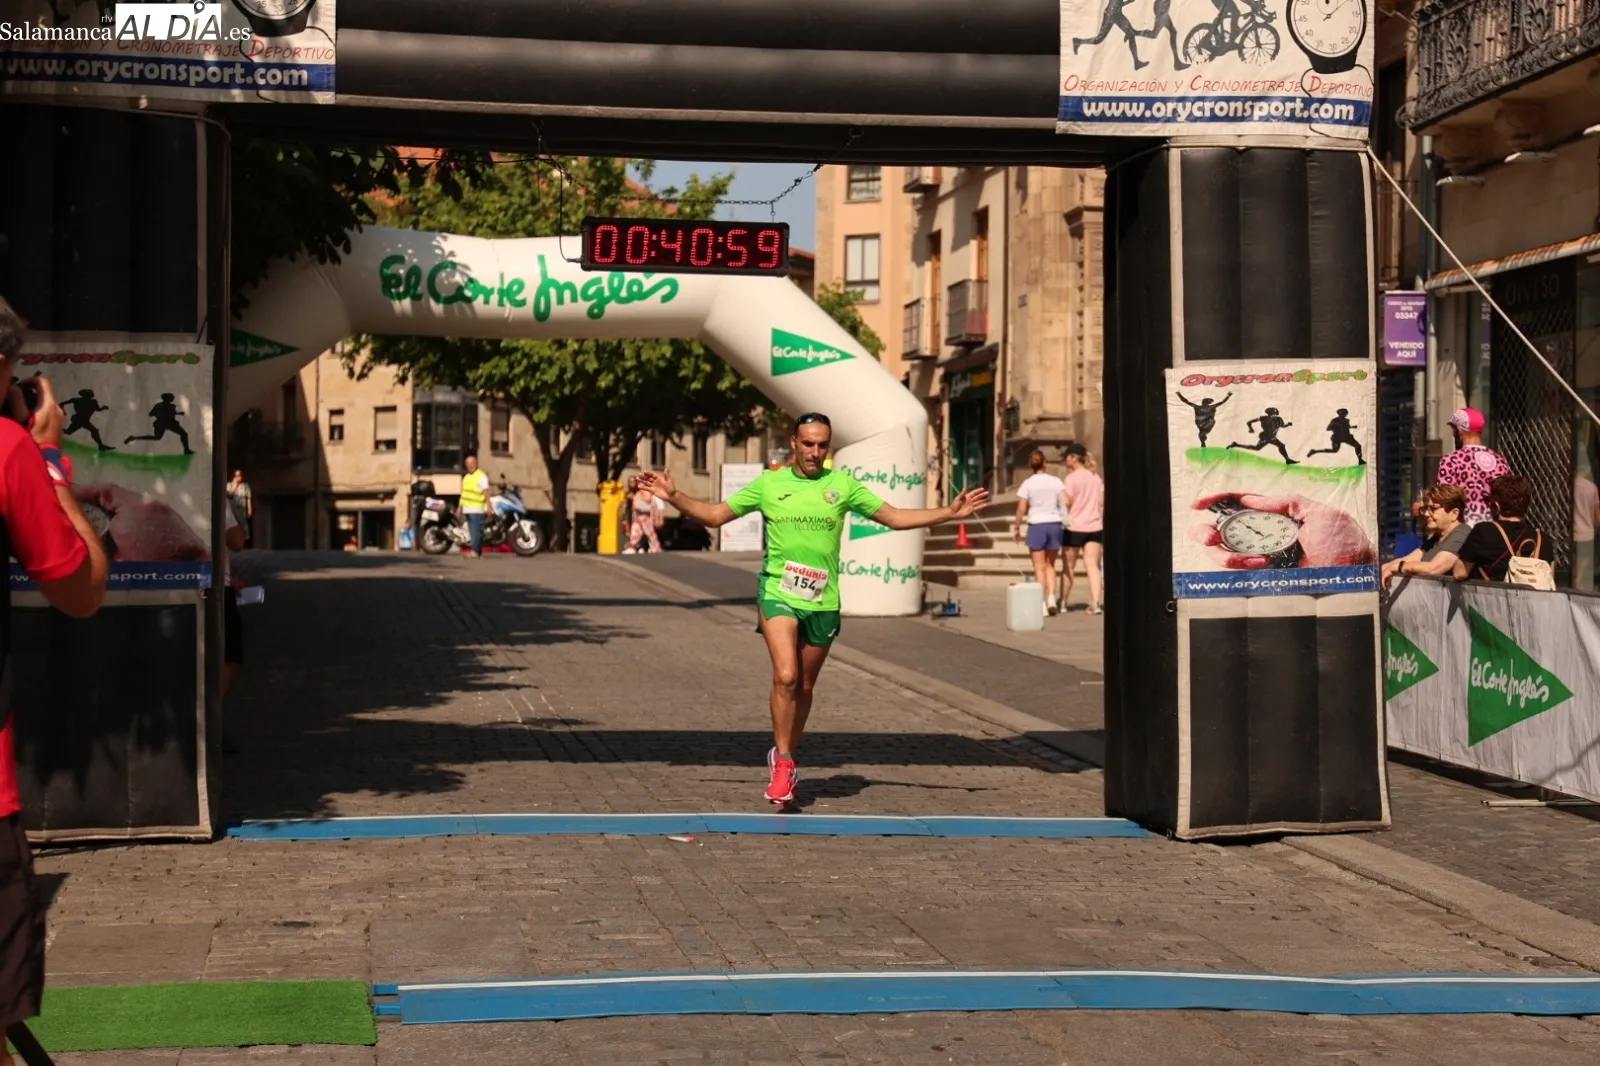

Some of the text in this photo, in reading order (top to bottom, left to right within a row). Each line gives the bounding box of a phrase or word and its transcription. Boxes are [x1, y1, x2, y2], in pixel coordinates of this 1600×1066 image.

[248, 38, 336, 61] DEPORTIVO
[1063, 73, 1167, 94] ORGANIZACIÓN
[1189, 74, 1302, 93] CRONOMETRAJE
[1307, 75, 1375, 98] DEPORTIVO
[1082, 98, 1355, 122] www.orycronsport.com
[593, 223, 782, 268] 00:40:59
[379, 254, 680, 323] El Corte Inglés
[1388, 341, 1425, 350] VENDIDO
[1180, 369, 1368, 388] OrycronSport
[852, 466, 888, 484] Corte
[846, 560, 882, 577] Corte
[793, 575, 816, 592] 154
[1188, 574, 1375, 591] www.orycronsport.com
[1387, 638, 1419, 682] Inglés
[1471, 657, 1550, 709] El Corte Inglés
